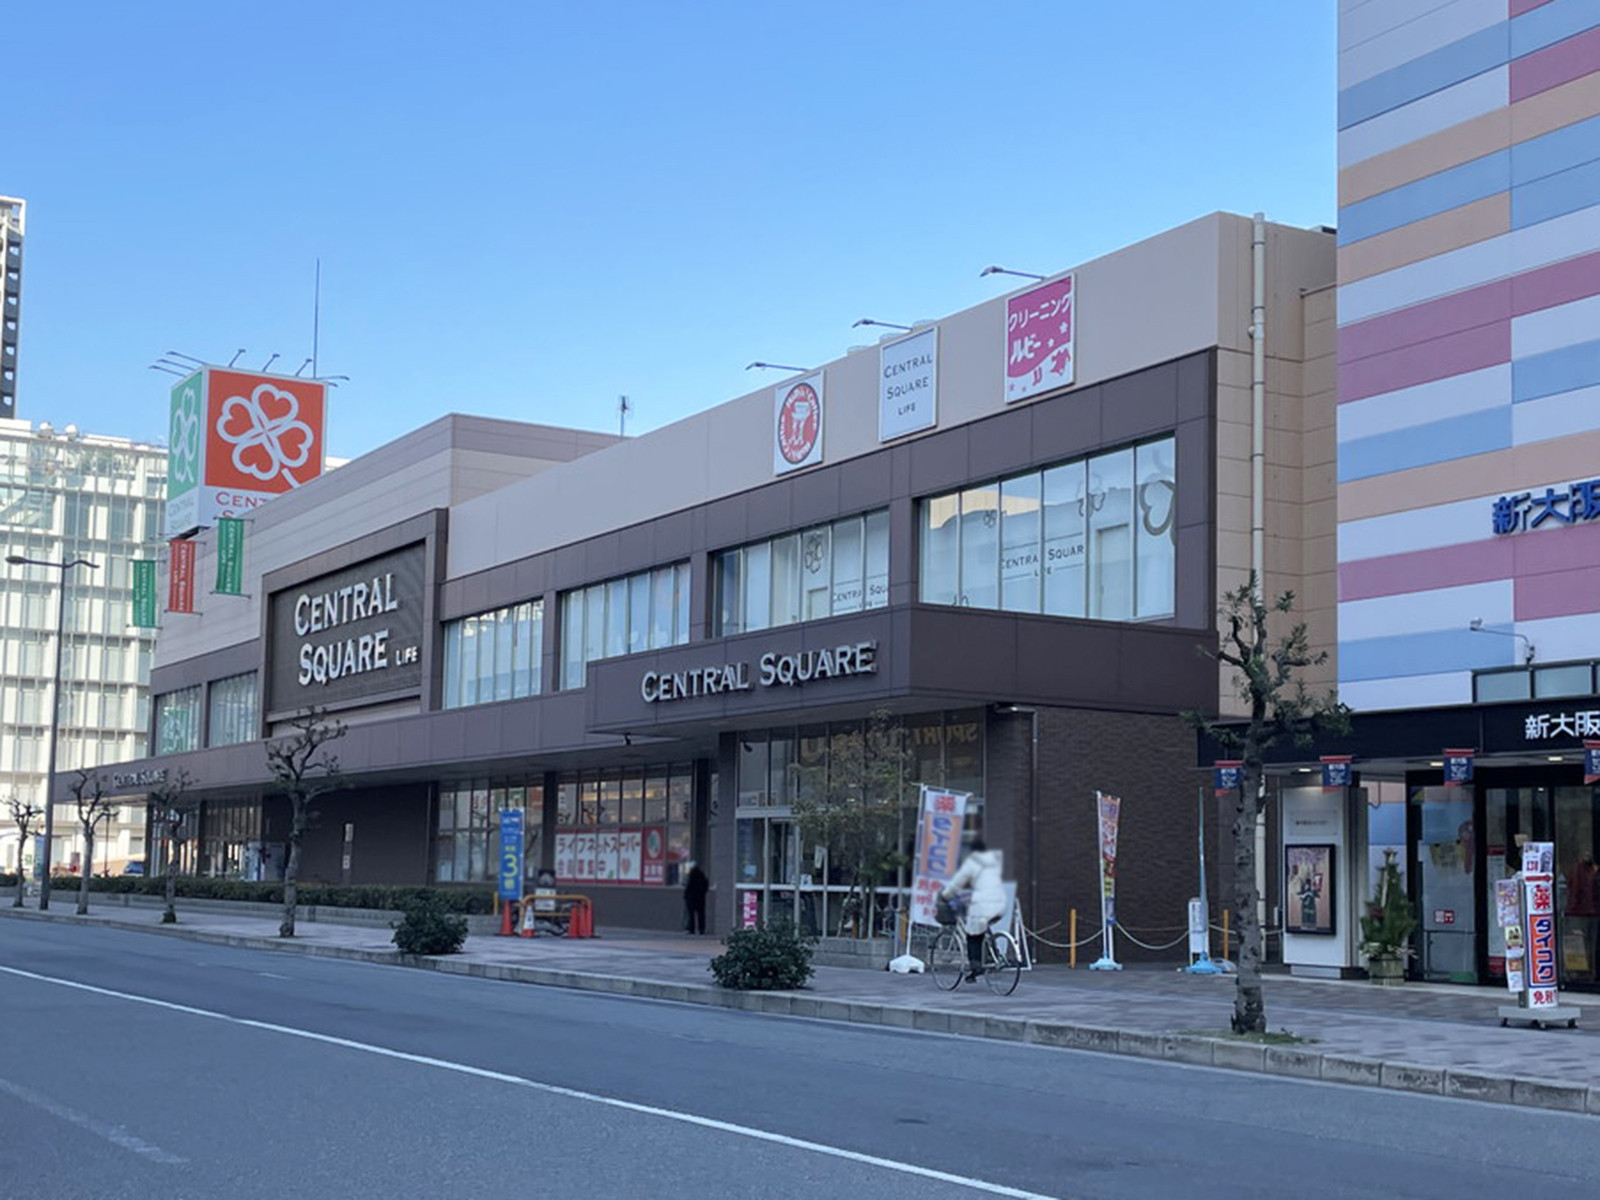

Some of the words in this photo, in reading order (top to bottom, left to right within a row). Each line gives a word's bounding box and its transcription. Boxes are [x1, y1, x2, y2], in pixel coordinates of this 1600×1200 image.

[1008, 292, 1072, 333] クリーニング
[1010, 333, 1041, 365] ルビー
[883, 354, 933, 379] CENTRAL
[886, 376, 929, 400] SQUARE
[898, 402, 916, 416] LIFE
[1492, 478, 1600, 534] 新大阪
[1000, 554, 1039, 570] CENTRA
[1047, 544, 1085, 561] SQUAR
[294, 573, 398, 636] CENTRAL
[299, 628, 389, 686] SQUARE
[396, 646, 418, 666] LIFE
[641, 662, 751, 703] CENTRAL
[759, 640, 877, 687] SQUARE
[1524, 710, 1600, 740] 新大阪
[503, 853, 518, 878] 3
